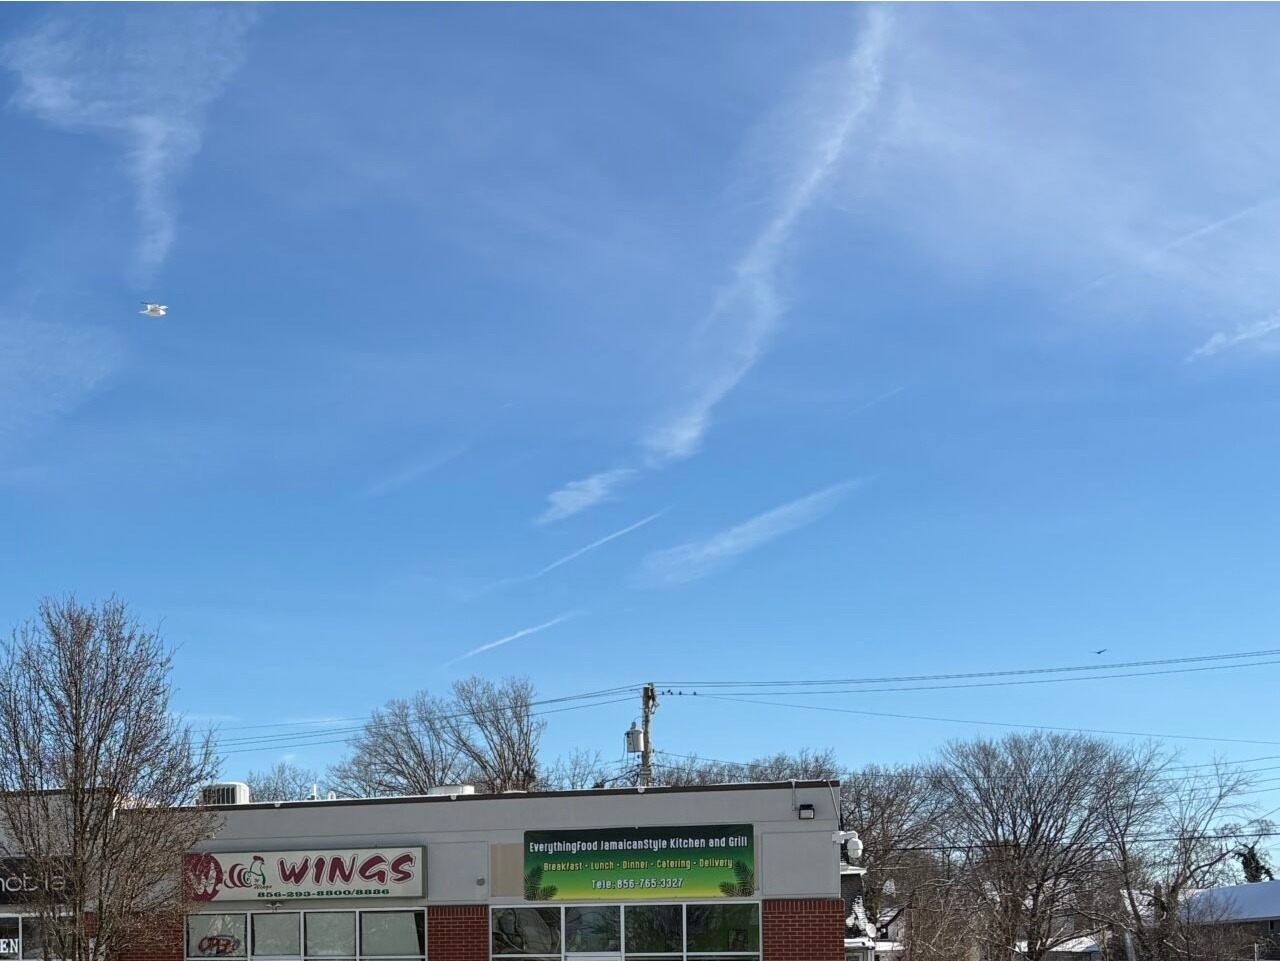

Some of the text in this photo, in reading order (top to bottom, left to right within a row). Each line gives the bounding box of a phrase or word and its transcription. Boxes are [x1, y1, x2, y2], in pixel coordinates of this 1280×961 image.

[529, 841, 598, 854] EverythingFood
[670, 837, 706, 849] Kitchen
[708, 837, 726, 848] and
[728, 835, 748, 847] Grill
[277, 853, 416, 886] WINGS
[543, 858, 734, 871] Breakfast Lunch Dinner Catering Delivery
[592, 878, 683, 889] Tele: 856-765-3327
